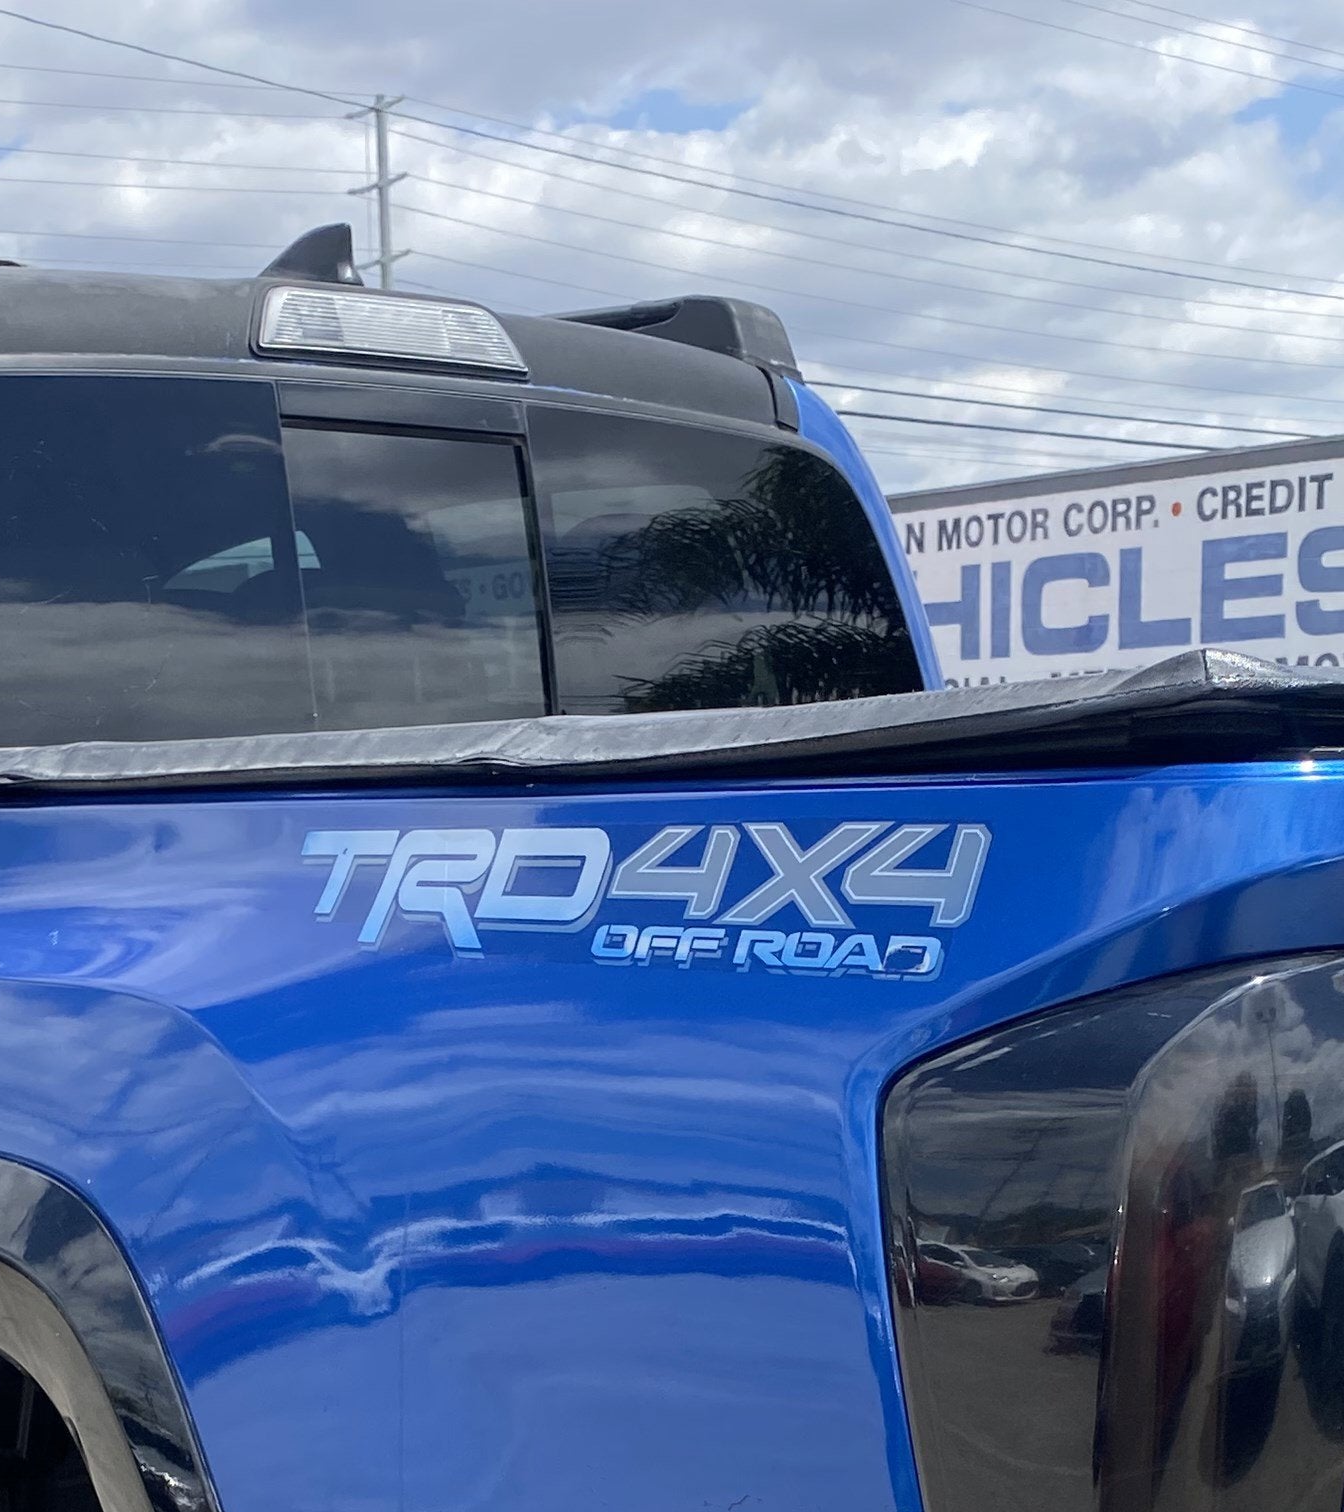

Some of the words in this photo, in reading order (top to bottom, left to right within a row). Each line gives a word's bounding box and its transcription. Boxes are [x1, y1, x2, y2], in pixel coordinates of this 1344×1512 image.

[937, 508, 1049, 551] MOTOR
[1063, 495, 1159, 538] CORP.
[1196, 473, 1333, 521] CREDIT
[301, 828, 613, 957] TRD
[606, 821, 993, 927] 4X4
[590, 924, 728, 969] OFF
[734, 929, 948, 981] ROAD
